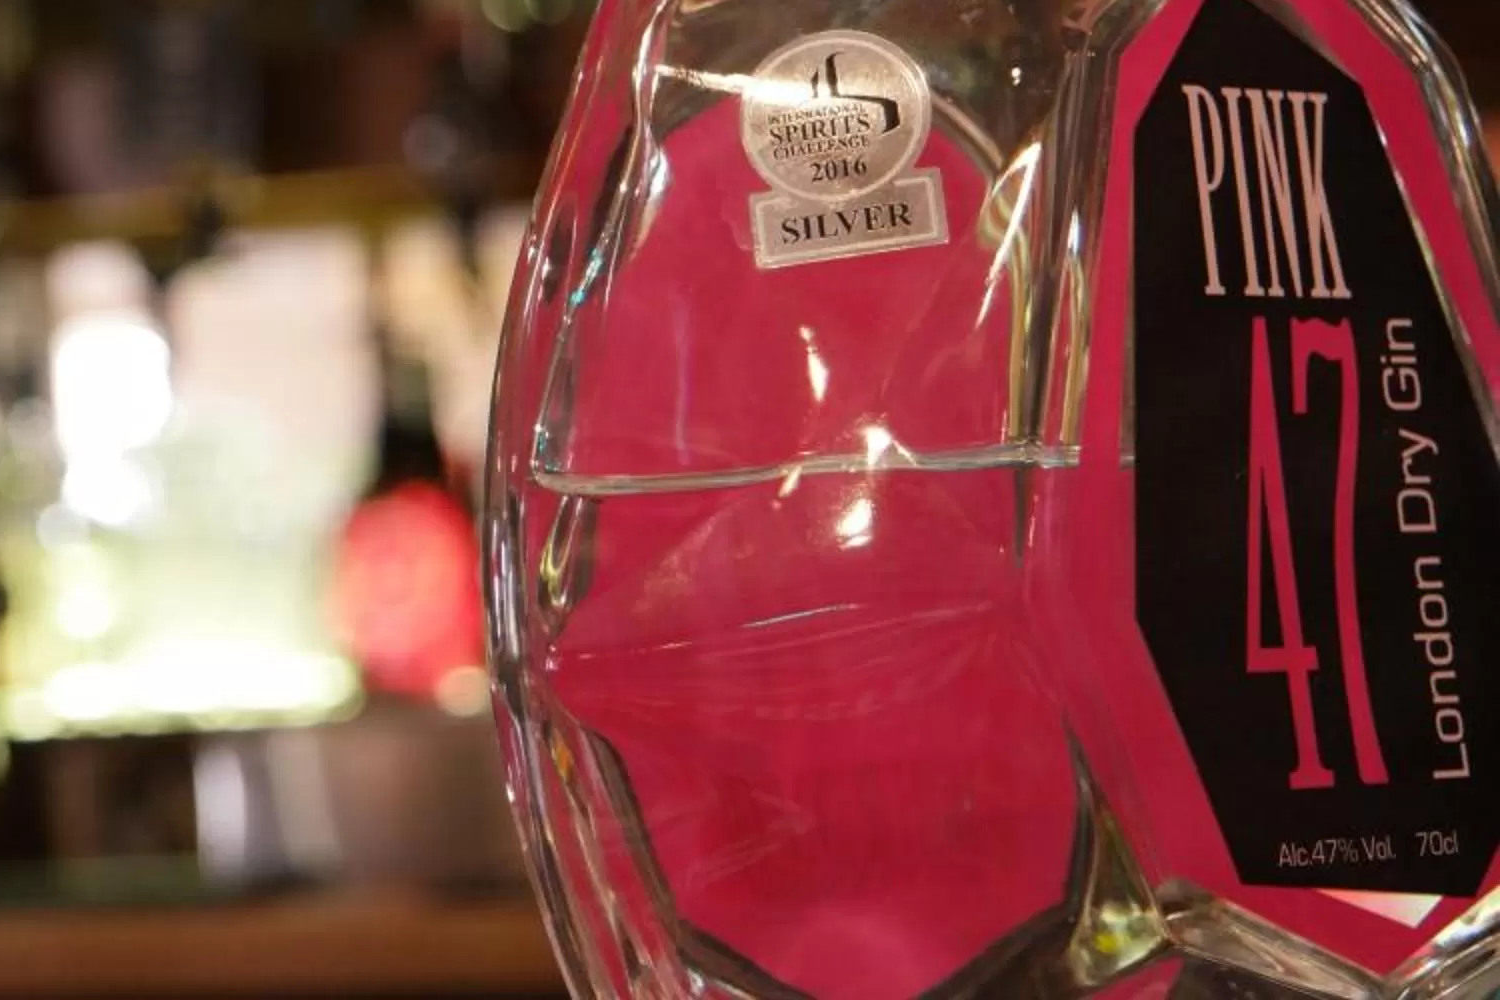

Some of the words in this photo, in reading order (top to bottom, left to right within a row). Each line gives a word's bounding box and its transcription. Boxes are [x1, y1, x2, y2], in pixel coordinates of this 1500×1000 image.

[769, 114, 871, 146] SPIRITS
[773, 134, 870, 161] CHALLENGE
[811, 155, 868, 183] 2016
[1181, 84, 1353, 299] PINK
[780, 201, 913, 245] SILVER
[1380, 318, 1421, 411] Gin
[1397, 428, 1439, 532] Dry
[1247, 316, 1389, 789] 47
[1413, 556, 1470, 779] London
[1415, 830, 1459, 857] 70cl
